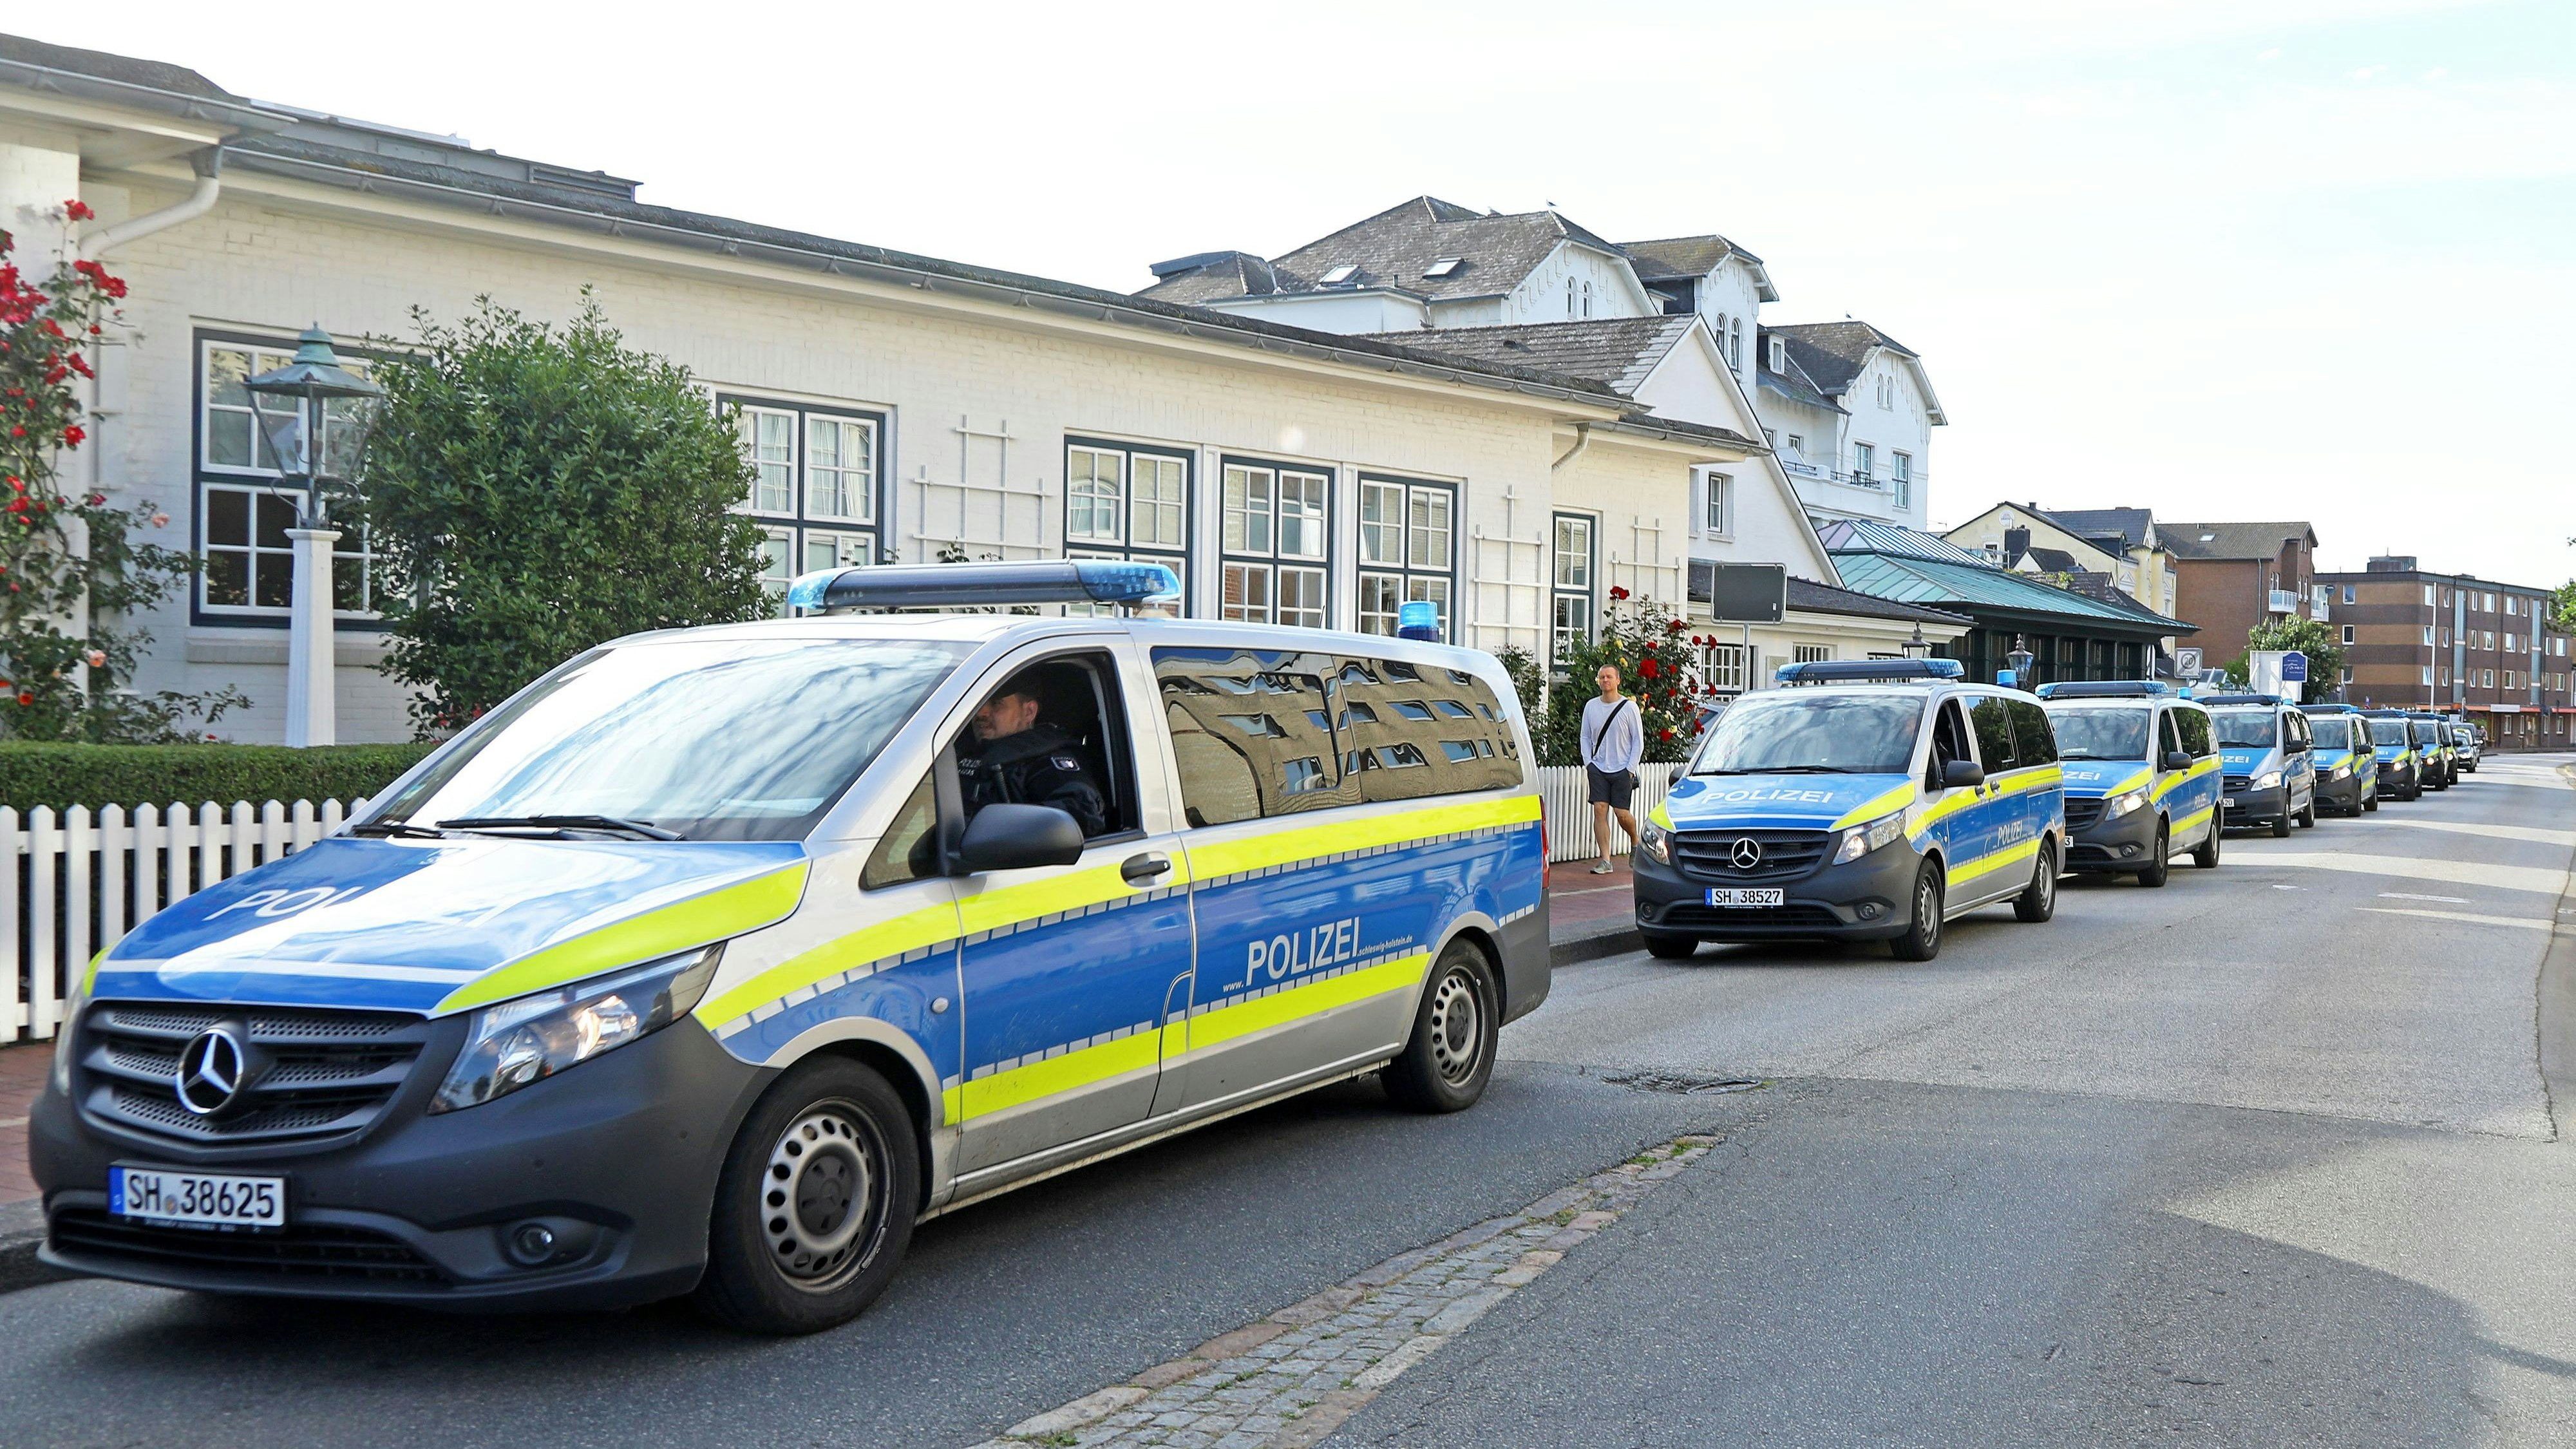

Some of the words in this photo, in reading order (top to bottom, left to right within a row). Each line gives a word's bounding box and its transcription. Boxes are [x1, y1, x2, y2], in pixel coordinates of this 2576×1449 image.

[2184, 657, 2193, 665] 20
[2062, 771, 2101, 781] ZEI
[1701, 789, 1833, 804] POLIZEI
[1997, 820, 2023, 848] POLIZEI
[1715, 890, 1732, 904] SH
[1740, 890, 1781, 904] 38527
[129, 1173, 161, 1211] SH
[181, 1178, 274, 1219] 38625
